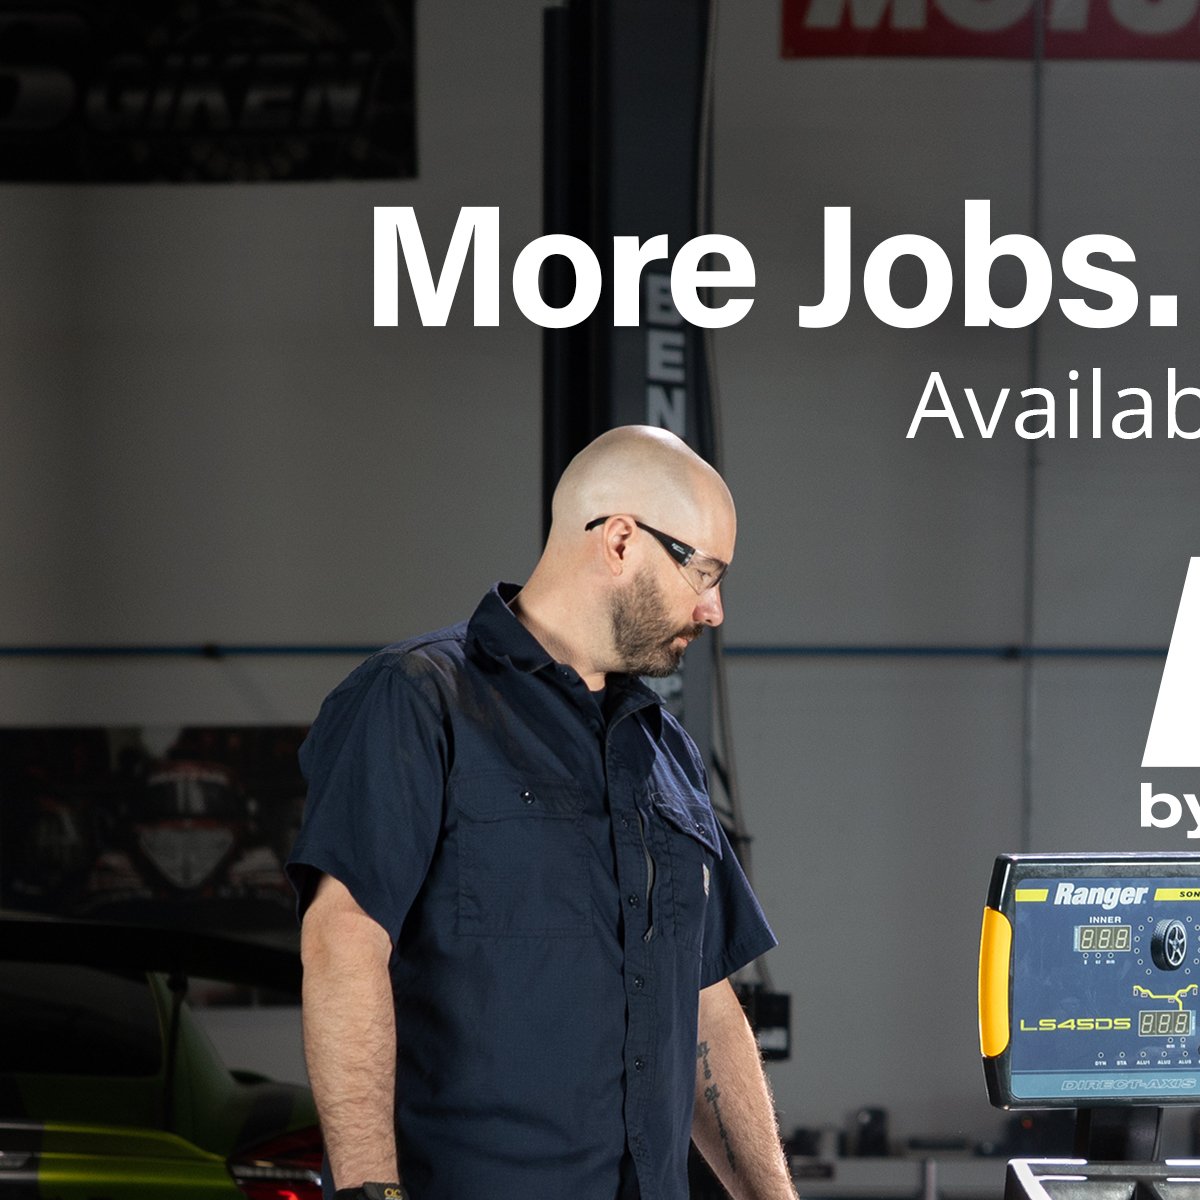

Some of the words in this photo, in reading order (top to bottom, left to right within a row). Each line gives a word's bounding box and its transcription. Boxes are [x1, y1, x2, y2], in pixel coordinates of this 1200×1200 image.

[1089, 916, 1122, 924] INNER
[1020, 1018, 1131, 1031] LS45DS
[1061, 1078, 1197, 1091] DIRECT-AXIS
